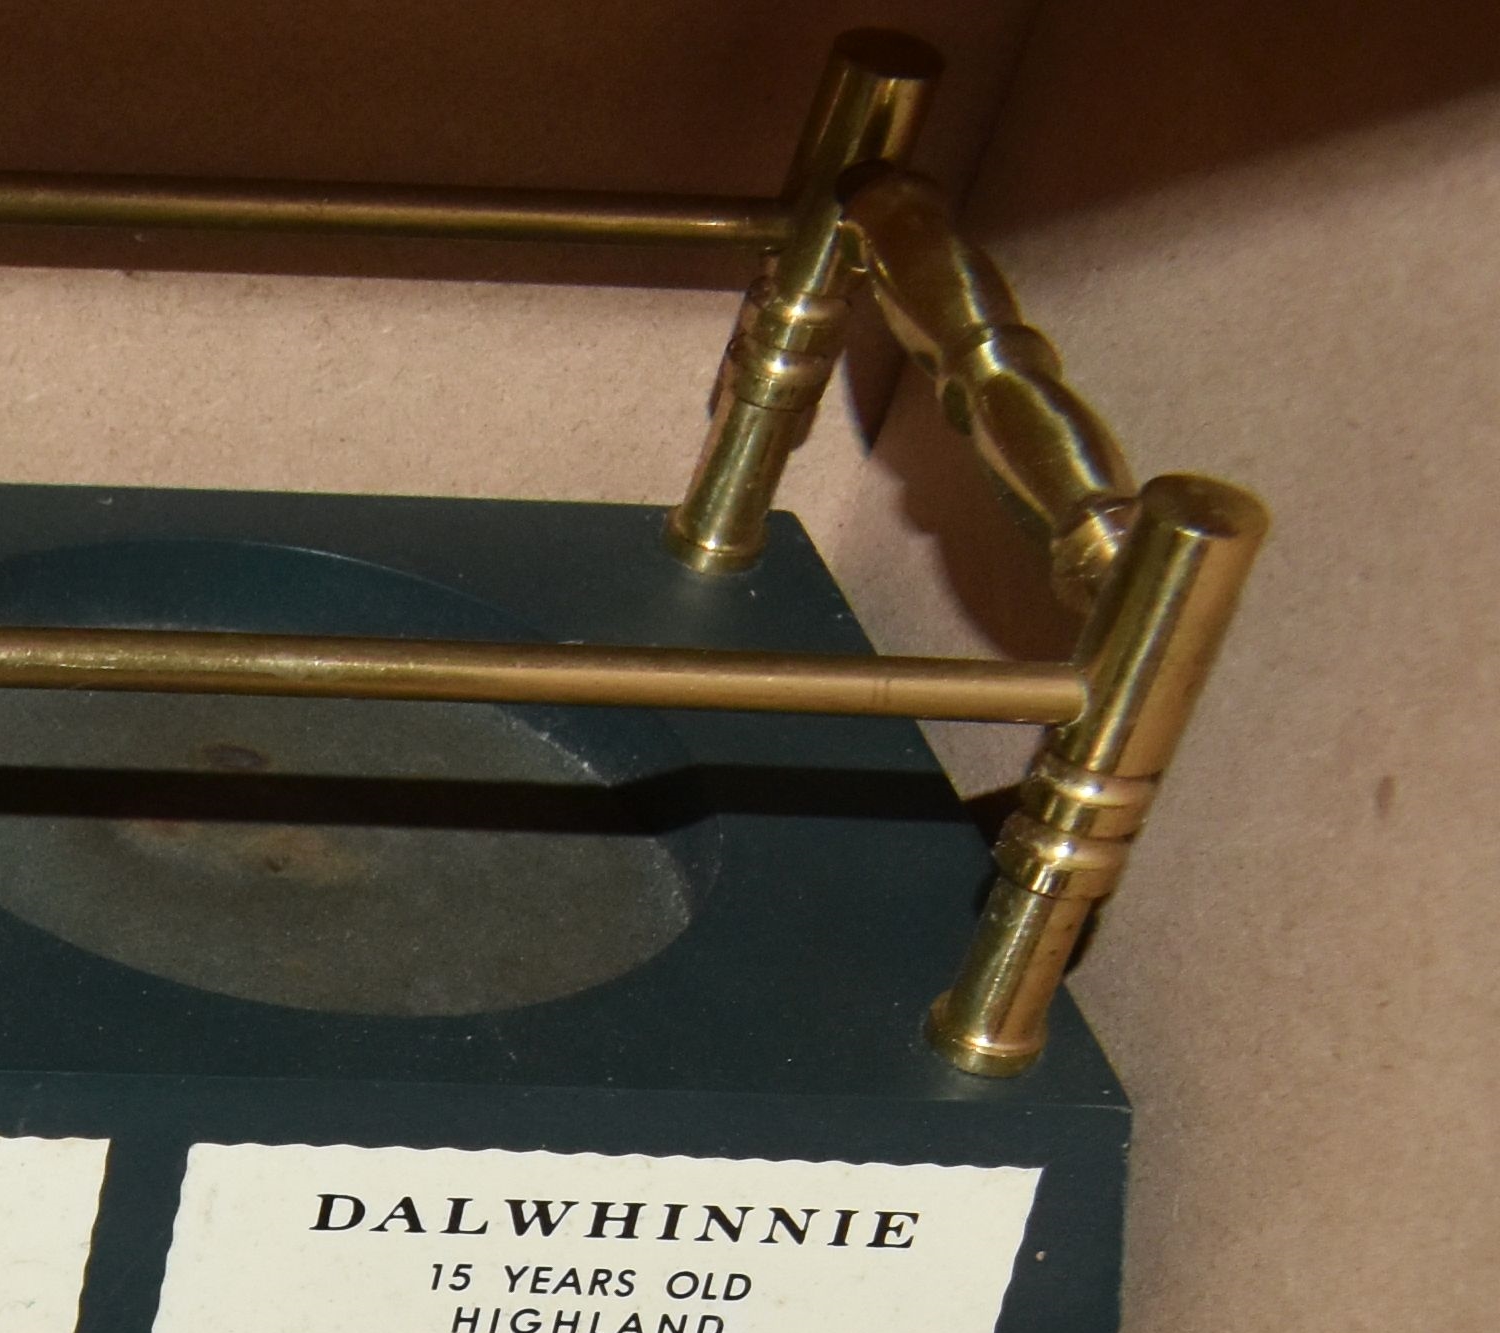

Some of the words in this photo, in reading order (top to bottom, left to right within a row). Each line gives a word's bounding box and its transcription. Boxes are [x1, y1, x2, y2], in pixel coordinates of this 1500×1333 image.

[309, 1193, 919, 1249] DALWHINNIE
[431, 1263, 473, 1291] 15
[504, 1265, 636, 1298] YEARS
[666, 1271, 752, 1301] OLD
